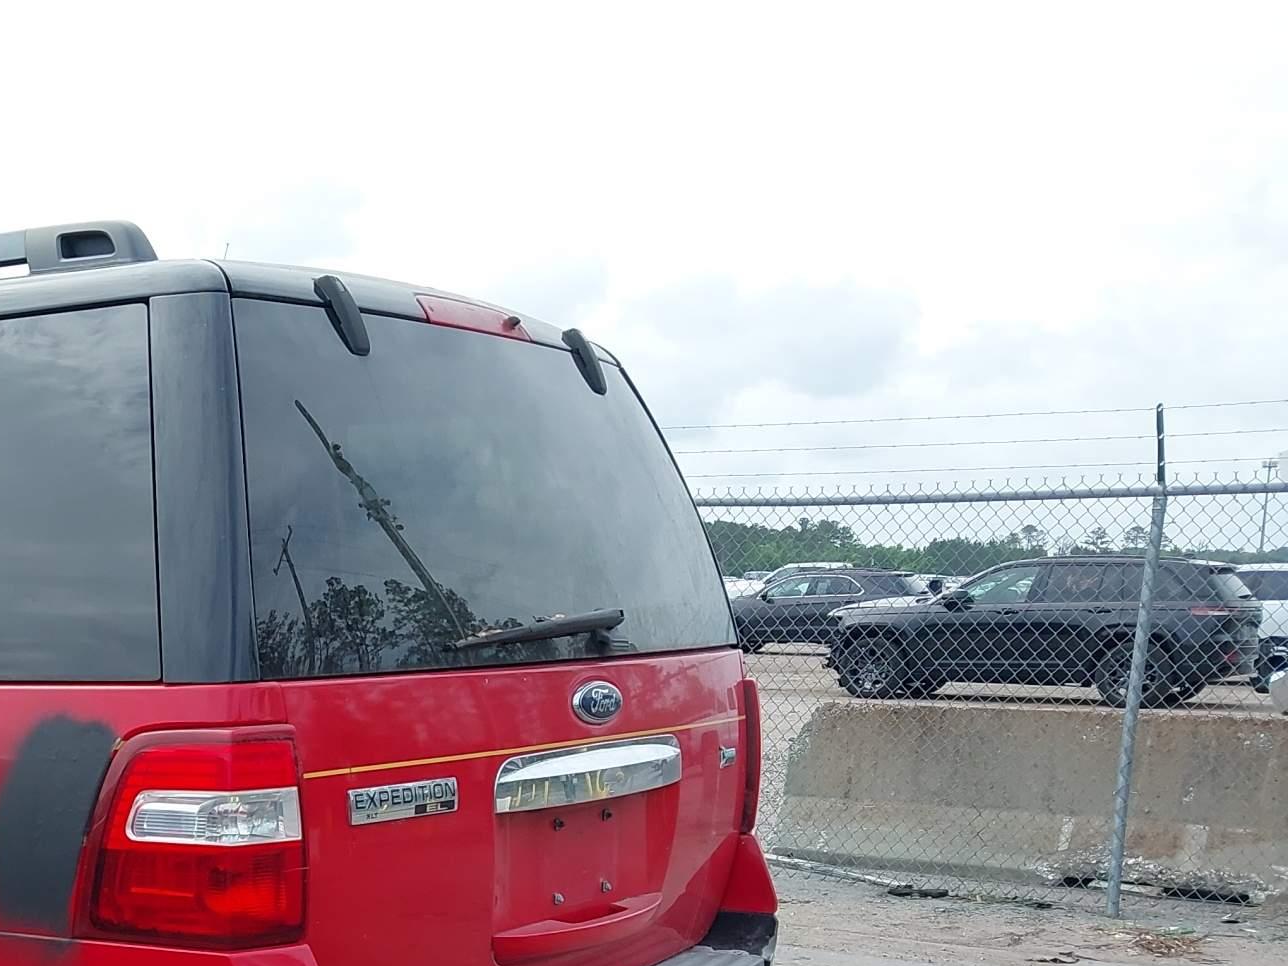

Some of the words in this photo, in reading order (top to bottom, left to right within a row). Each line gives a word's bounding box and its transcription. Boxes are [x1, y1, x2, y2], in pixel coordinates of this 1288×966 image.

[591, 688, 616, 713] Ford
[354, 781, 456, 810] EXPEDITION
[426, 803, 449, 813] EL
